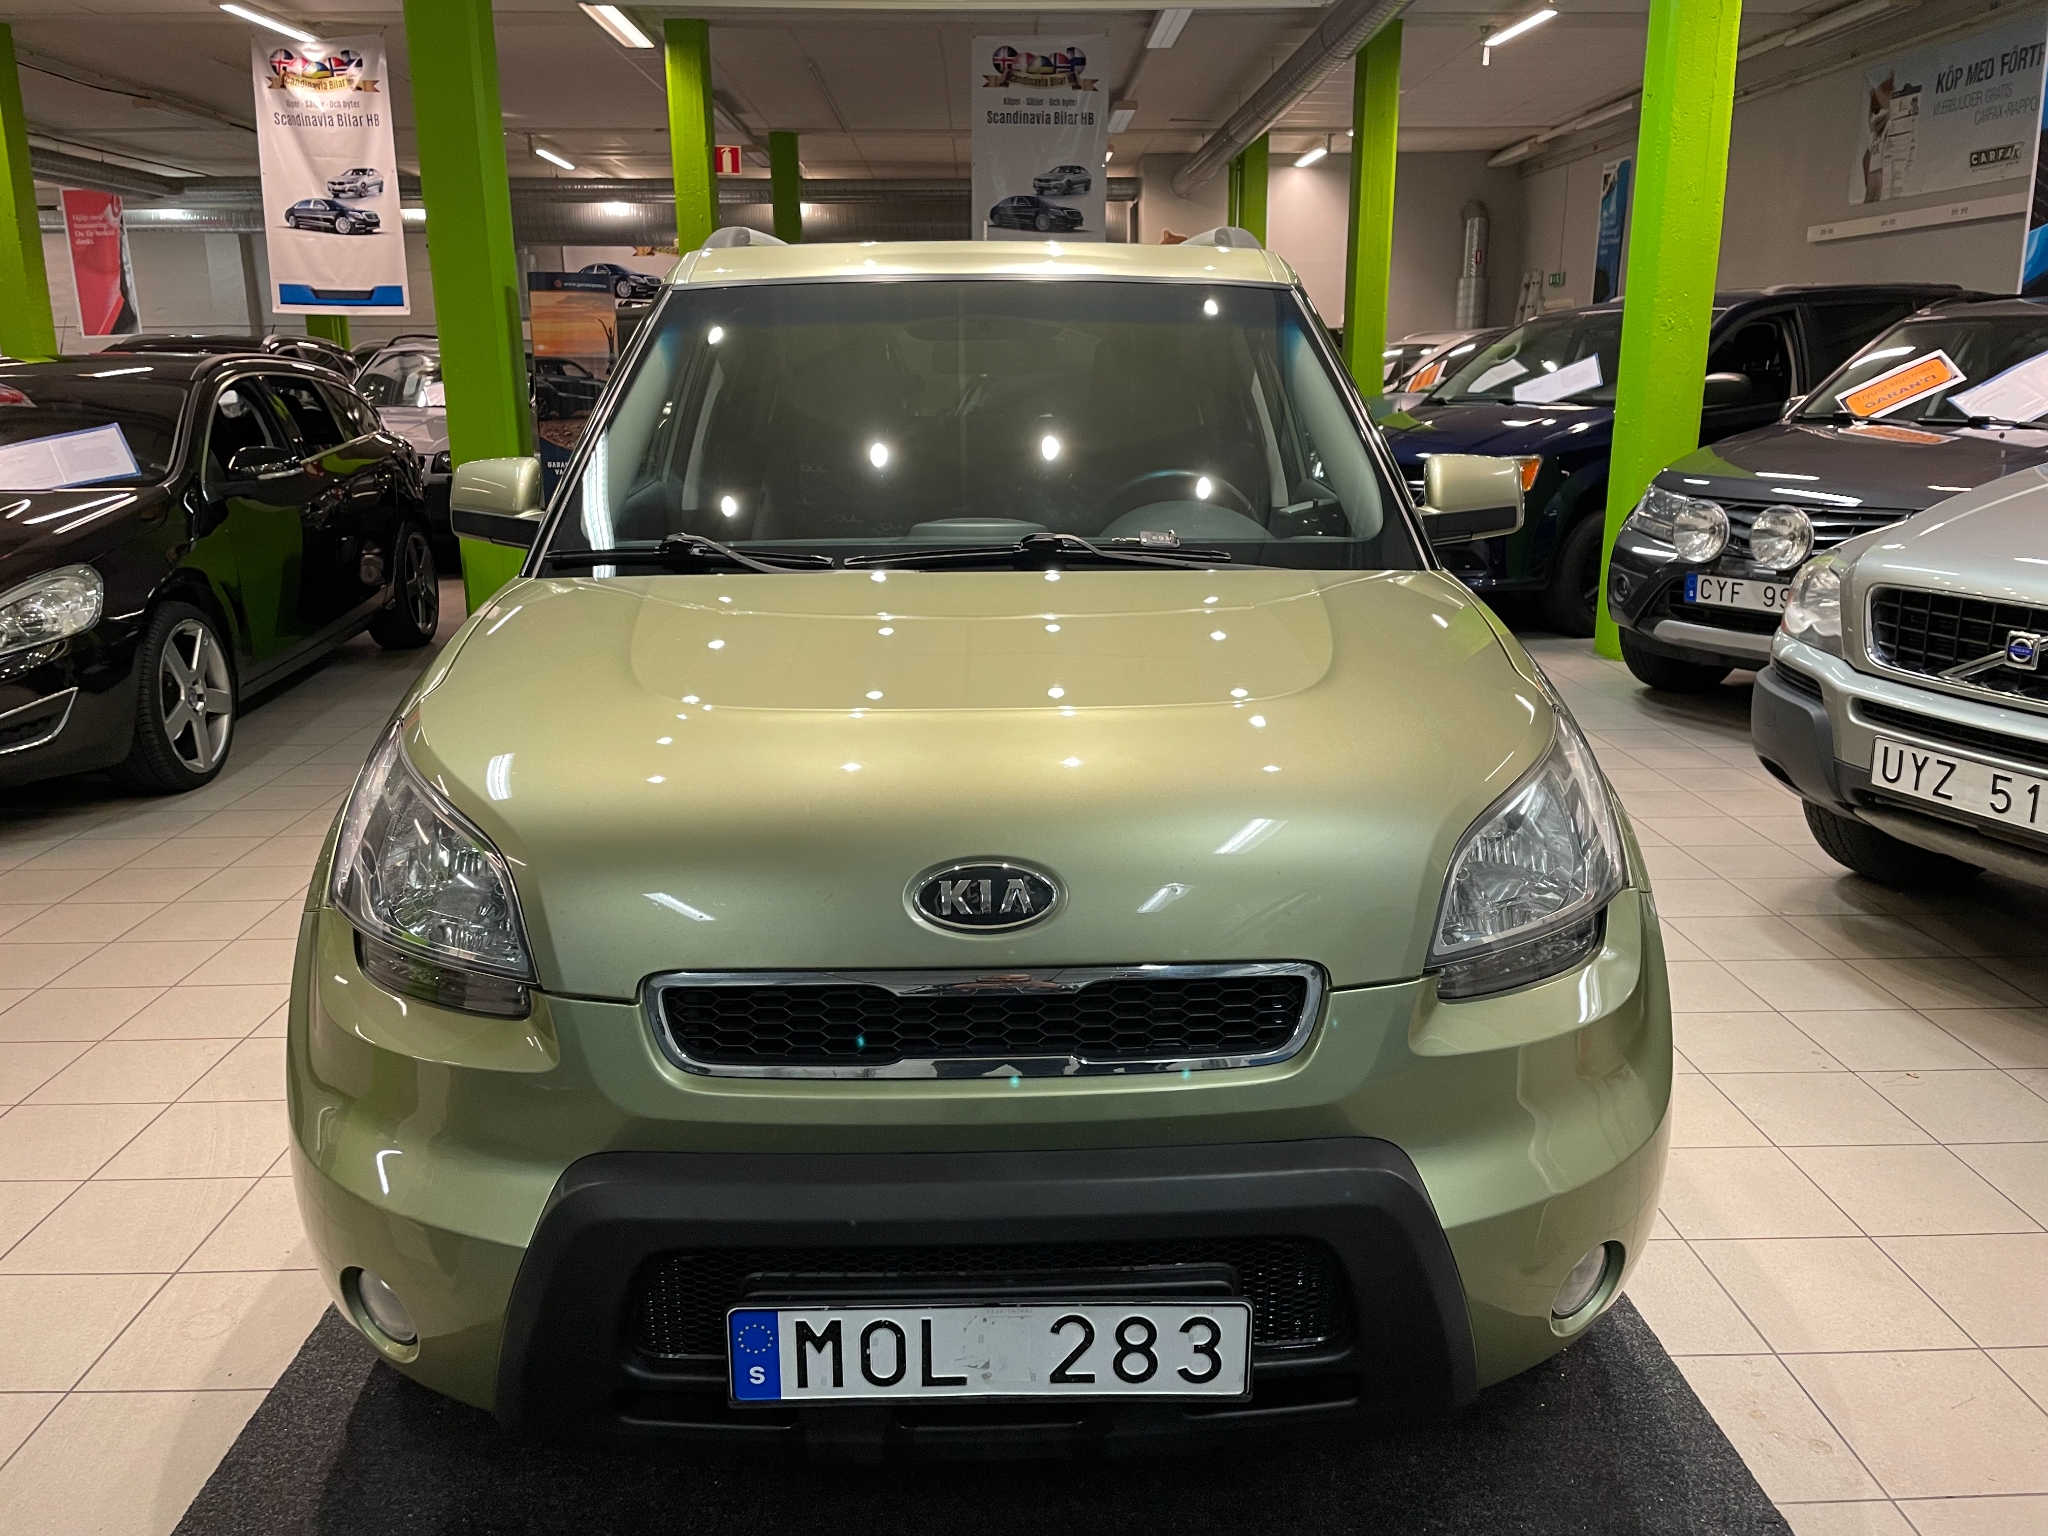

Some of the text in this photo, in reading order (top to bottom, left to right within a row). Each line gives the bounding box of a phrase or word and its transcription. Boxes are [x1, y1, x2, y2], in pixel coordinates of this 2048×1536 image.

[329, 79, 346, 90] Bilar
[1936, 64, 1963, 94] KÖP
[1965, 58, 1995, 86] MED
[343, 100, 360, 109] byter
[274, 112, 380, 127] Scandinavia Bilar HB
[988, 111, 1094, 125] Scandinavia Bilar HB
[1971, 145, 2021, 165] CARFAX
[1864, 374, 1938, 409] GARANTI
[1700, 578, 1744, 603] CYF
[1882, 746, 2041, 824] UYZ 51
[939, 878, 1034, 915] KIA
[796, 1314, 1222, 1389] MOL 283
[749, 1366, 766, 1385] S
